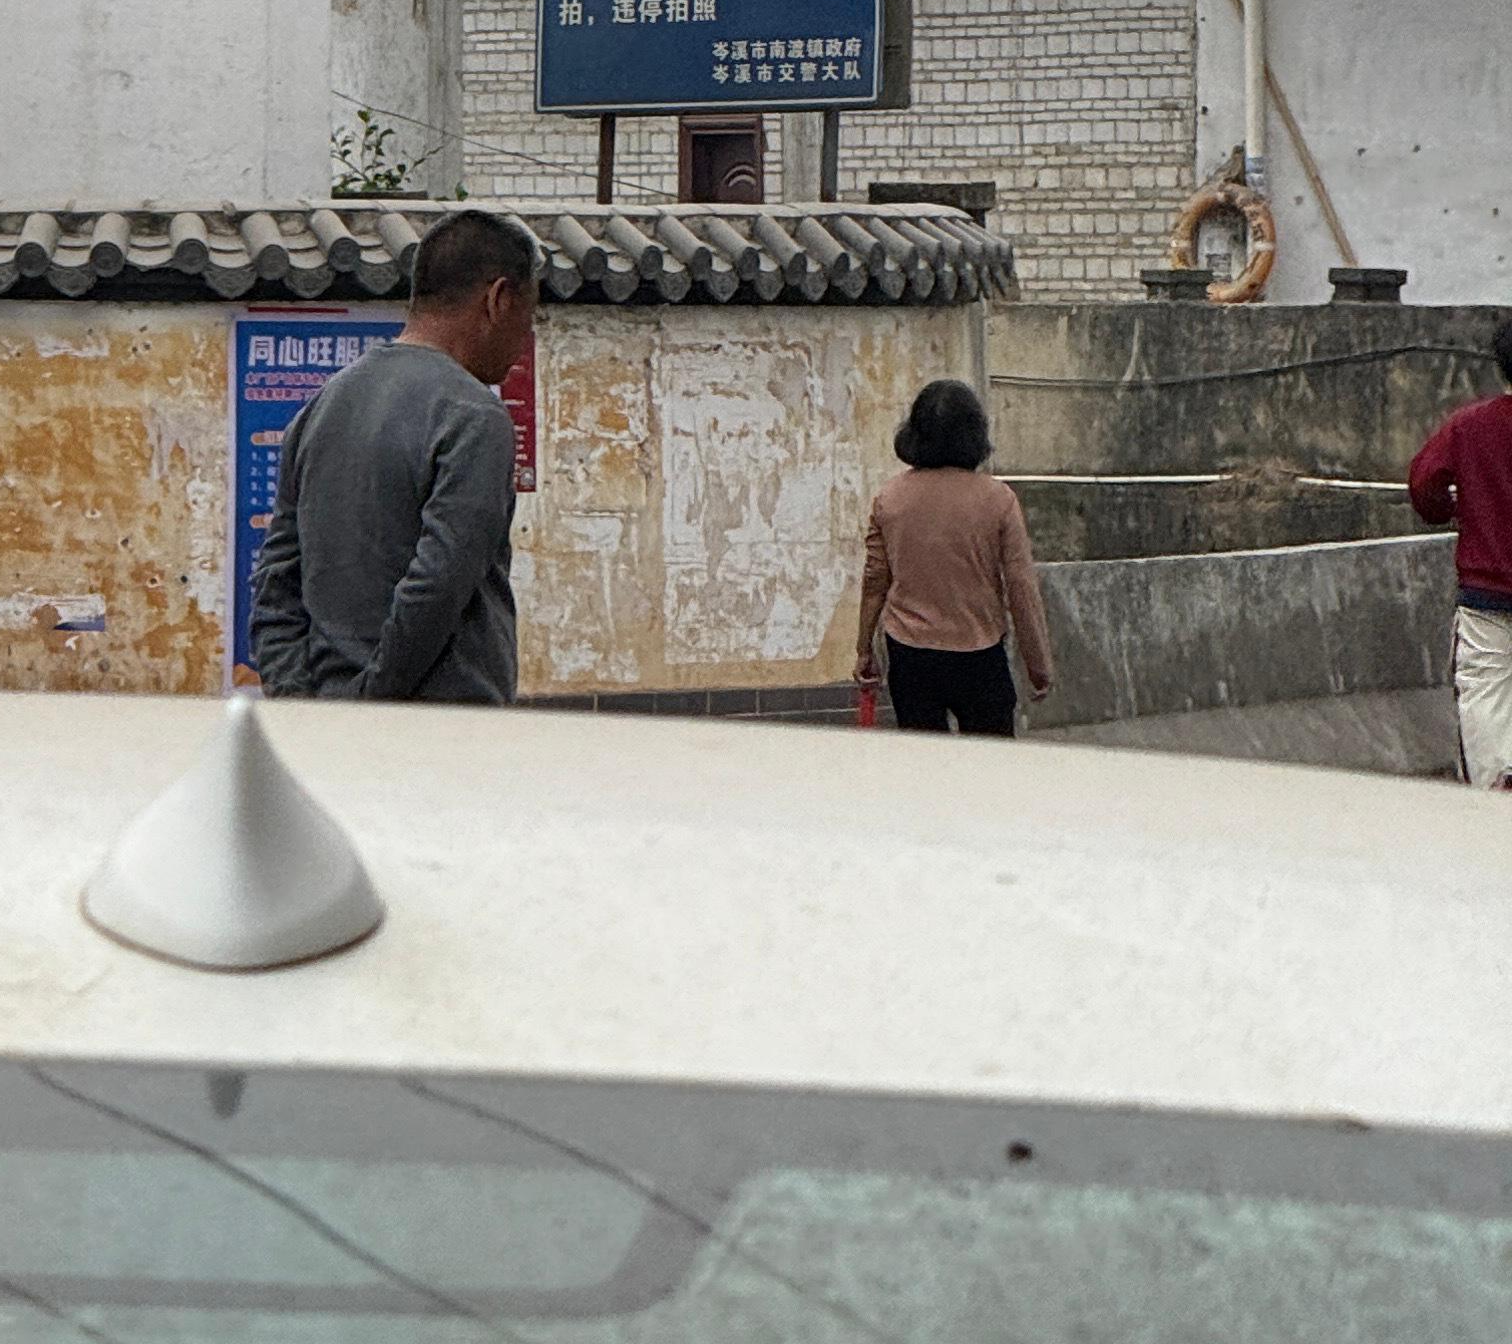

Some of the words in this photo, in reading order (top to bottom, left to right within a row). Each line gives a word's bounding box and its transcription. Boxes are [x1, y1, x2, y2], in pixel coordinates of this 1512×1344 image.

[711, 37, 863, 62] 岑溪市南渡镇政府
[711, 60, 862, 85] 岑溪市交警大队
[248, 335, 386, 367] 同心旺服
